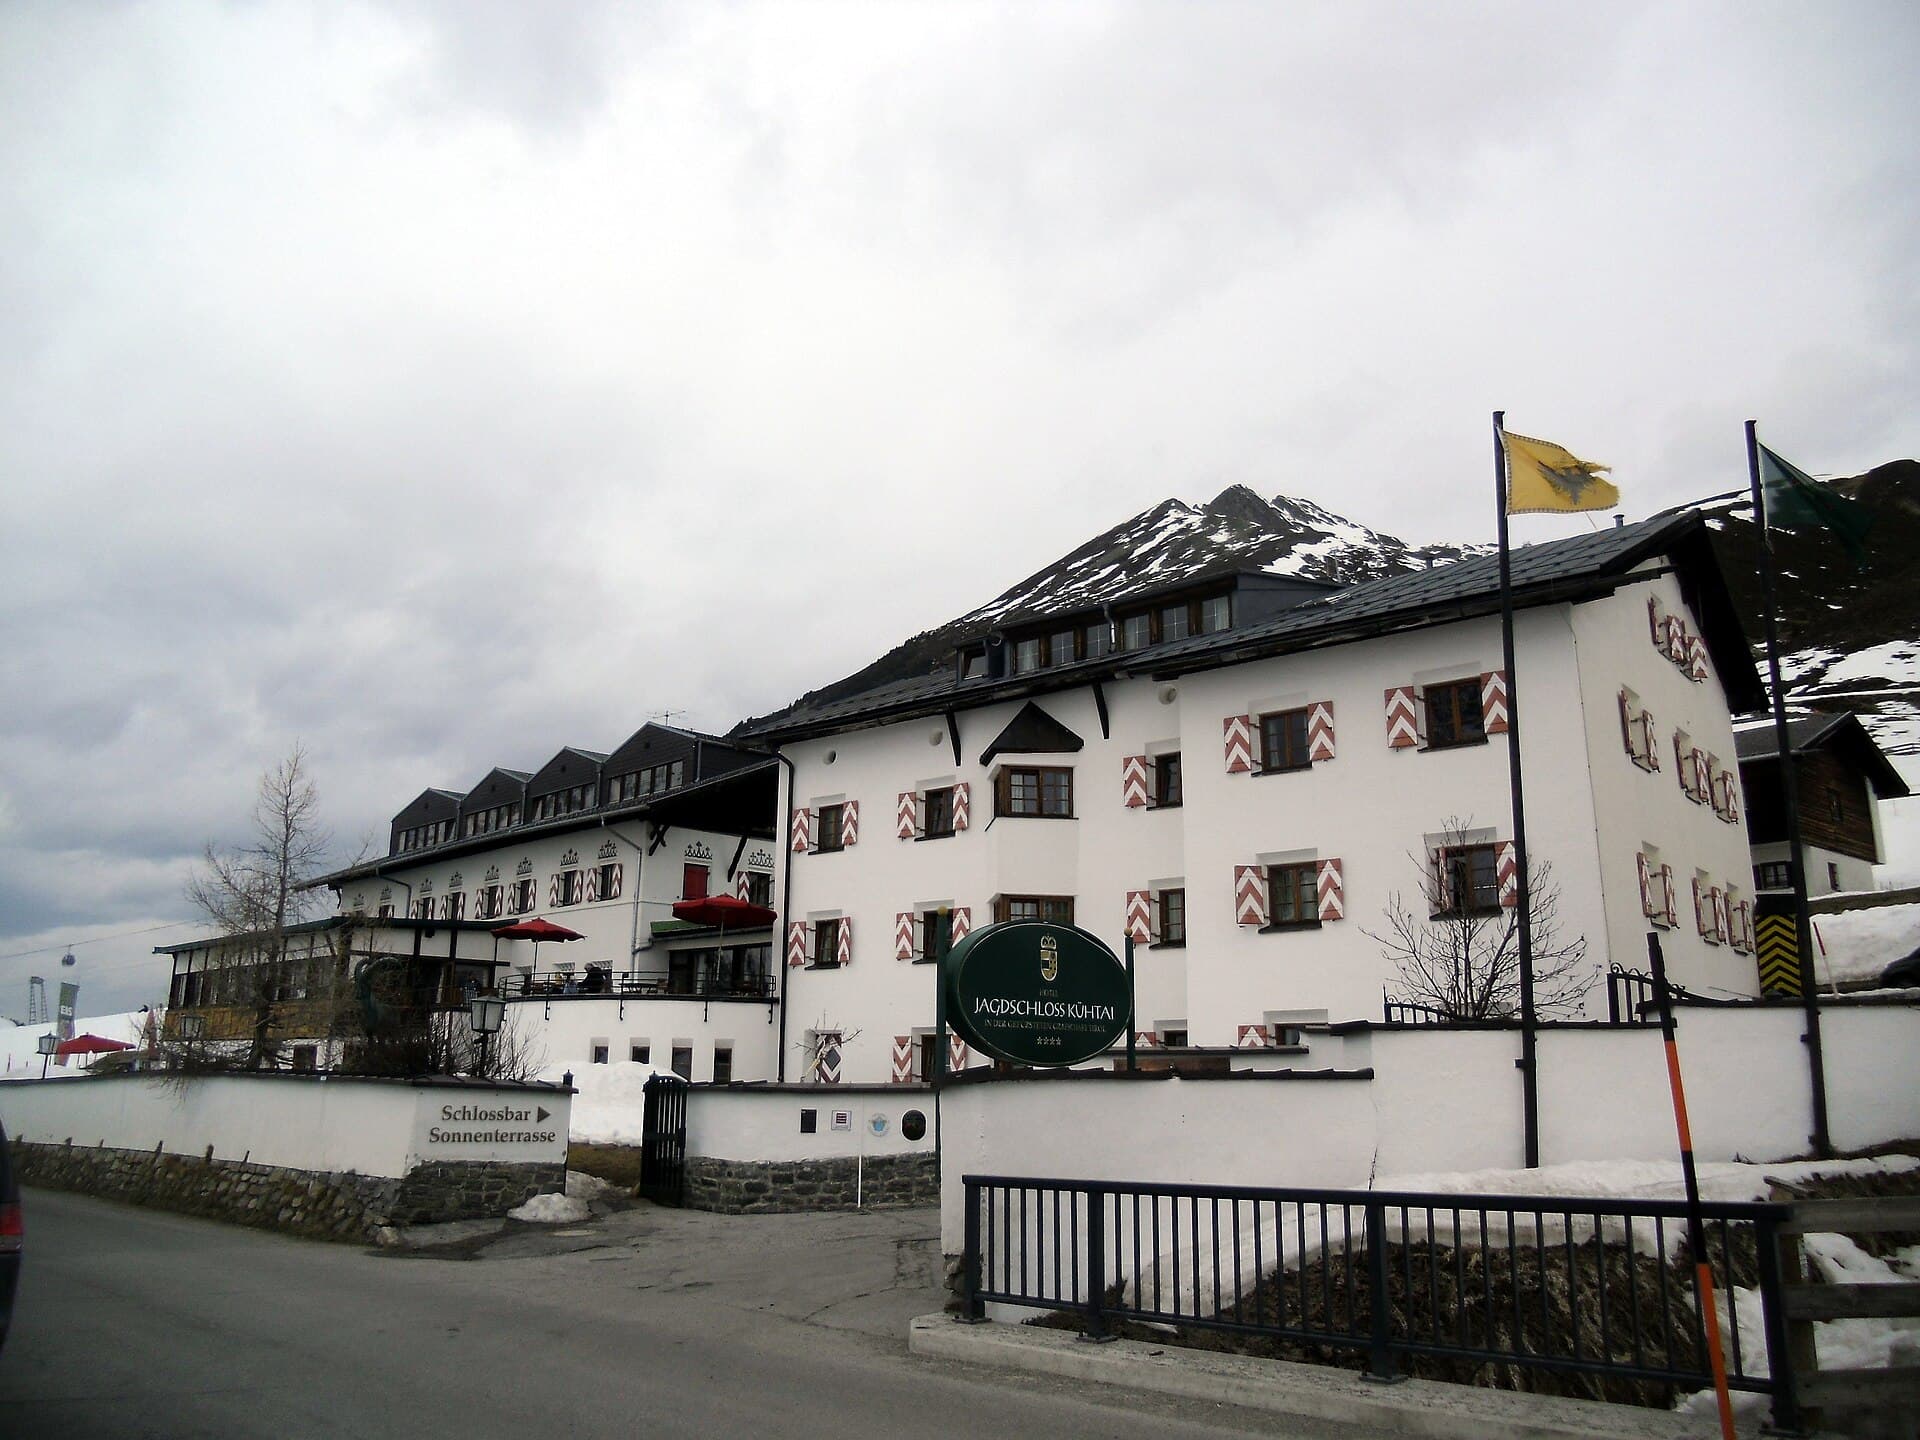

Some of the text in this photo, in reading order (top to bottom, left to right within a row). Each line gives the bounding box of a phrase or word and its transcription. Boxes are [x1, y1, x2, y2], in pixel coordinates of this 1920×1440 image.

[974, 997, 1115, 1020] JAGDSCHLOSS KÜHTAI
[442, 1105, 531, 1121] Schlossbar
[429, 1127, 556, 1143] Sonnenterrasse
